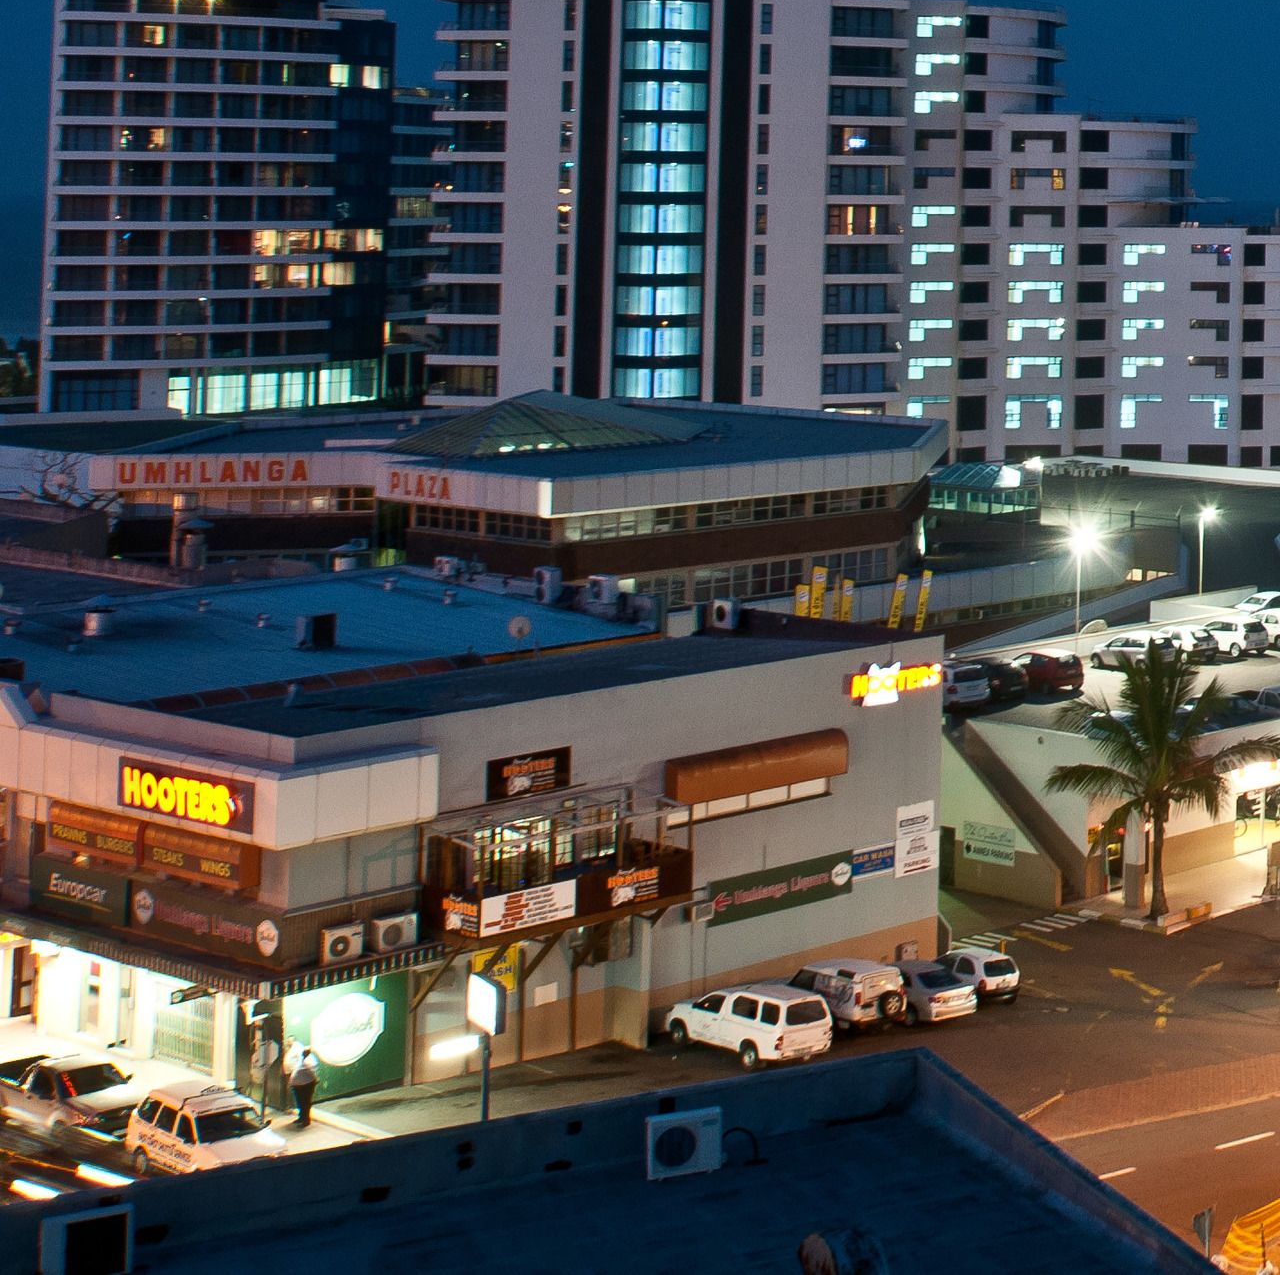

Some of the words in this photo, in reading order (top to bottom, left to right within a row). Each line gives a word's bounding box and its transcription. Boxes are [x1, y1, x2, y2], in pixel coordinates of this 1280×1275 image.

[117, 459, 309, 485] UMHLANGA
[388, 471, 451, 500] PLAZA
[850, 663, 942, 699] HOOTERS
[123, 766, 231, 826] HOOTERS
[52, 823, 88, 845] PRAWNS
[96, 834, 135, 856] BURGERS
[152, 847, 184, 867] STEAKS
[200, 858, 231, 877] WINGS
[49, 873, 107, 902] Europcar
